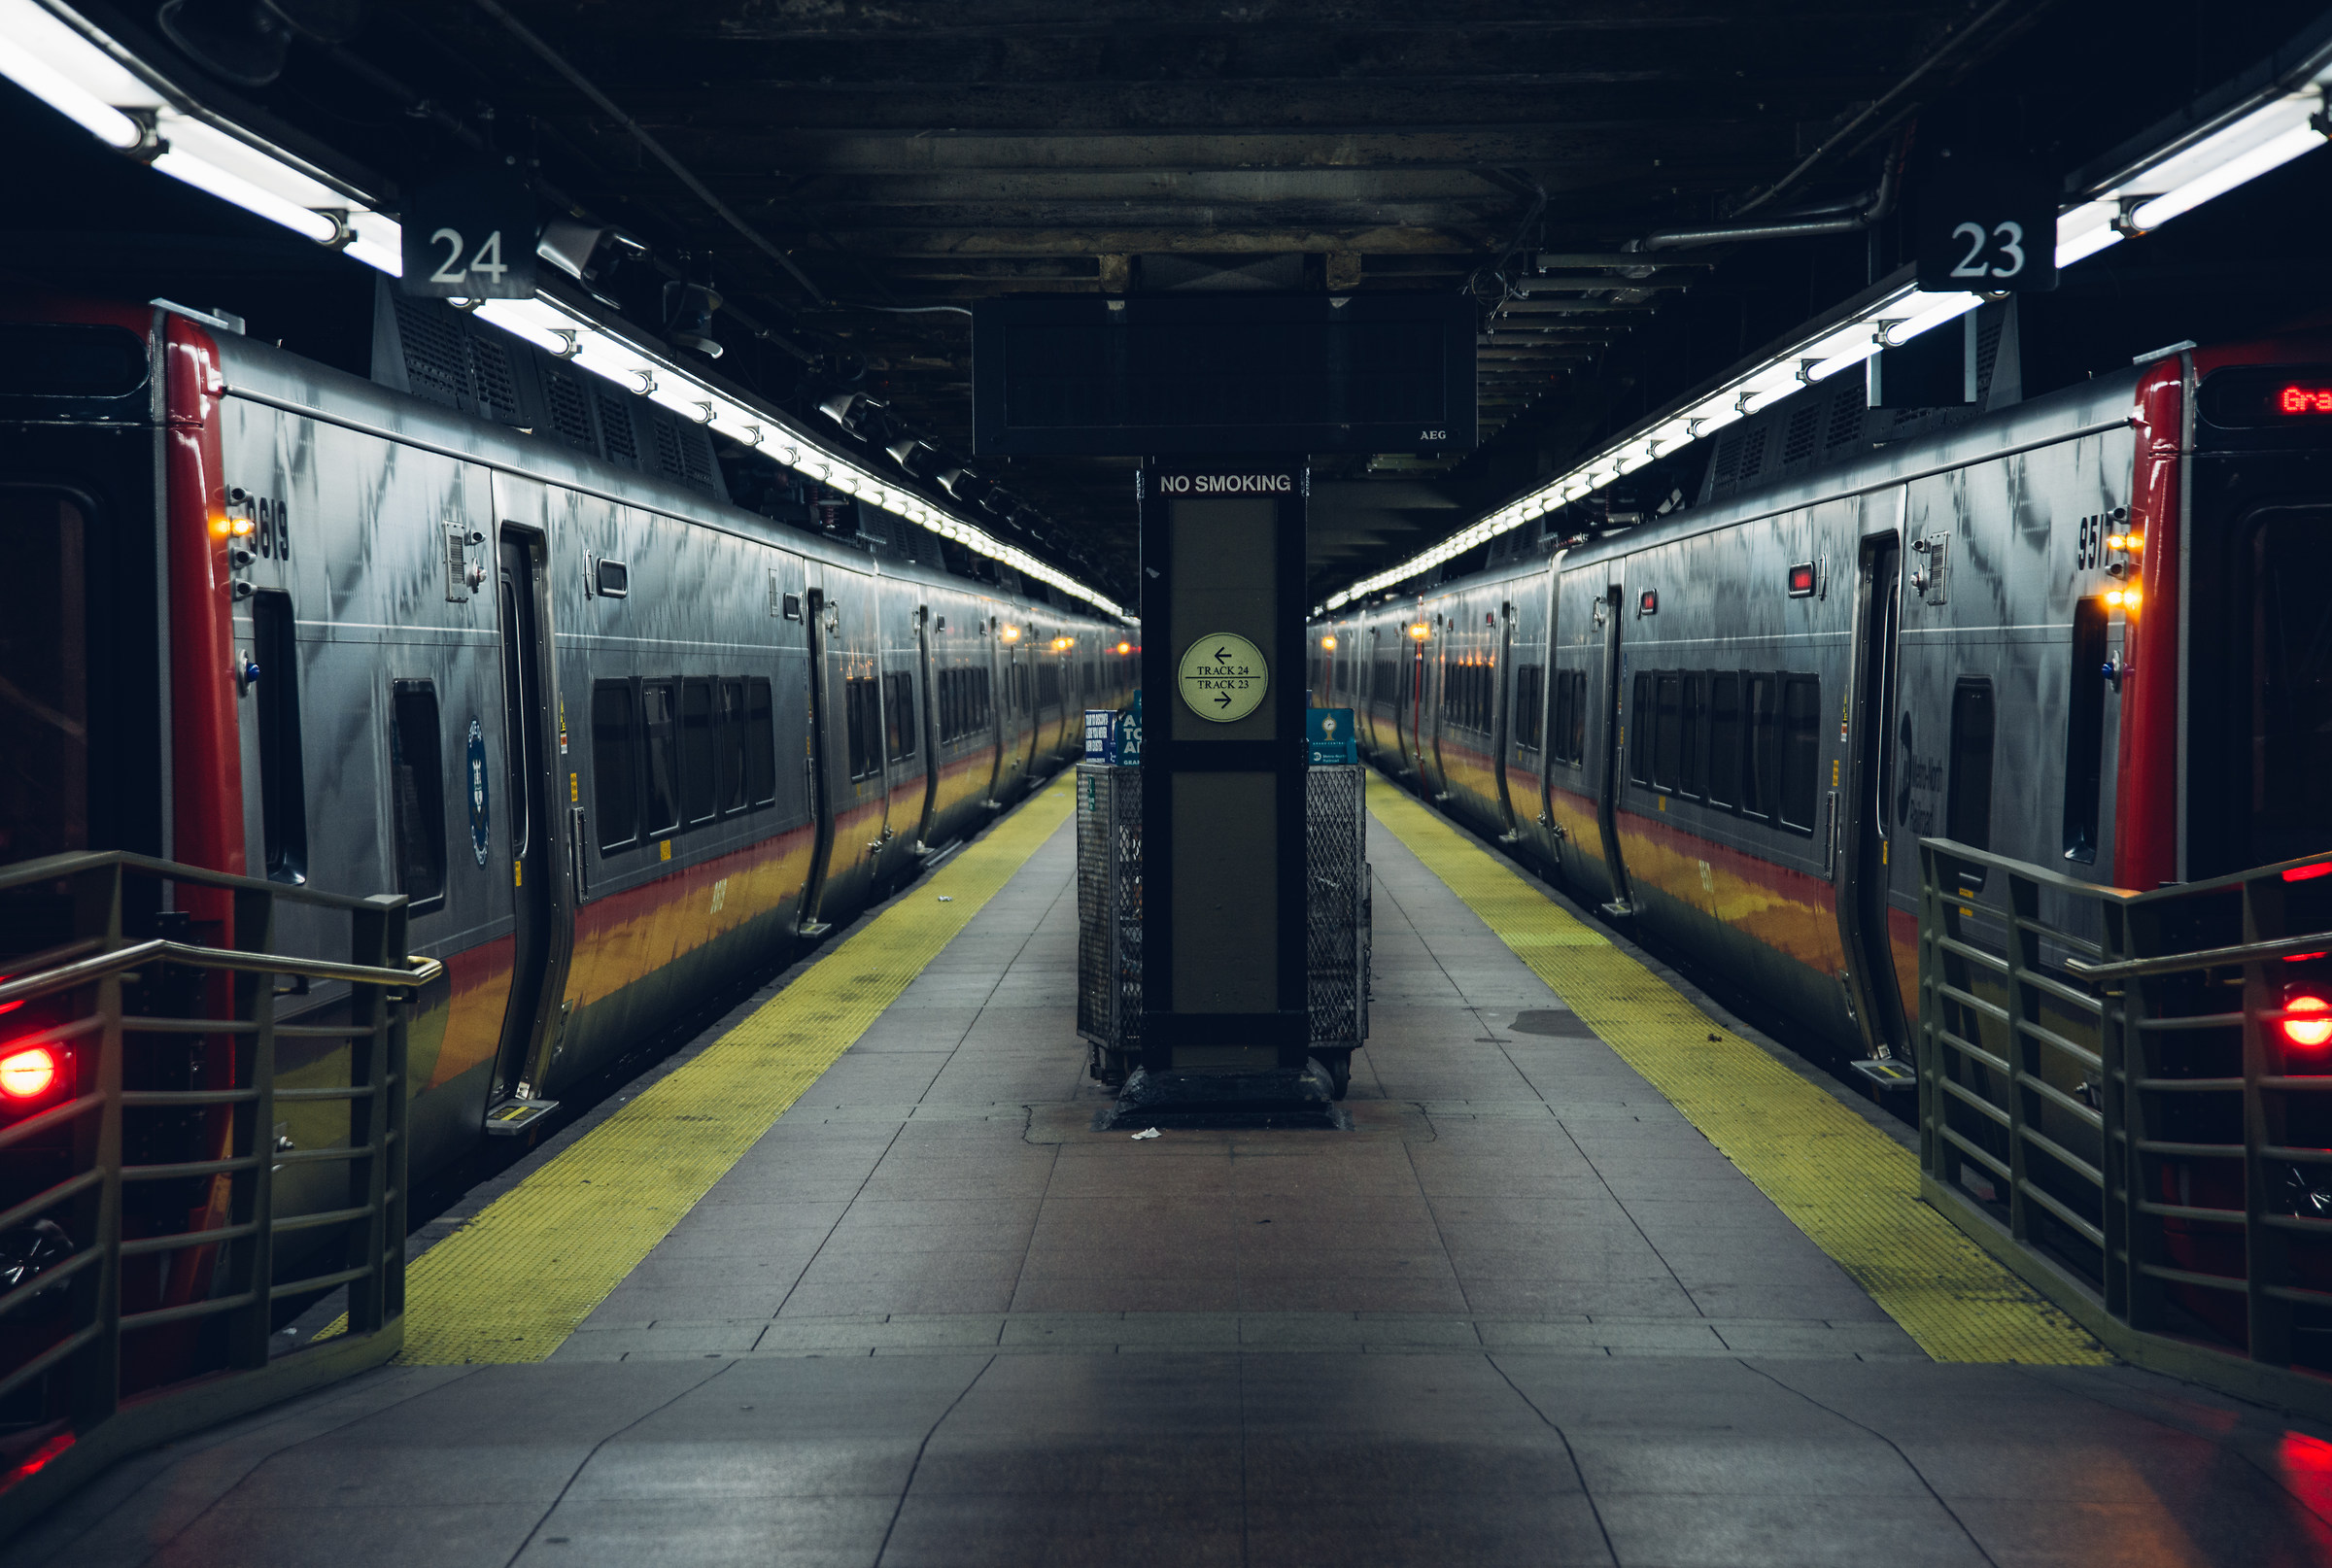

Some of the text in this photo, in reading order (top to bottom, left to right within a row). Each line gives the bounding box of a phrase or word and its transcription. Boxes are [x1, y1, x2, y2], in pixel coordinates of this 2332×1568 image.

[430, 227, 508, 284] 24
[1950, 222, 2025, 277] 23
[2283, 389, 2332, 411] Gra
[1420, 430, 1447, 440] AEG
[1160, 474, 1291, 493] NO SMOKING
[1196, 665, 1250, 675] TRACK 24
[1196, 679, 1250, 689] TRACK 23
[1123, 714, 1136, 727] A
